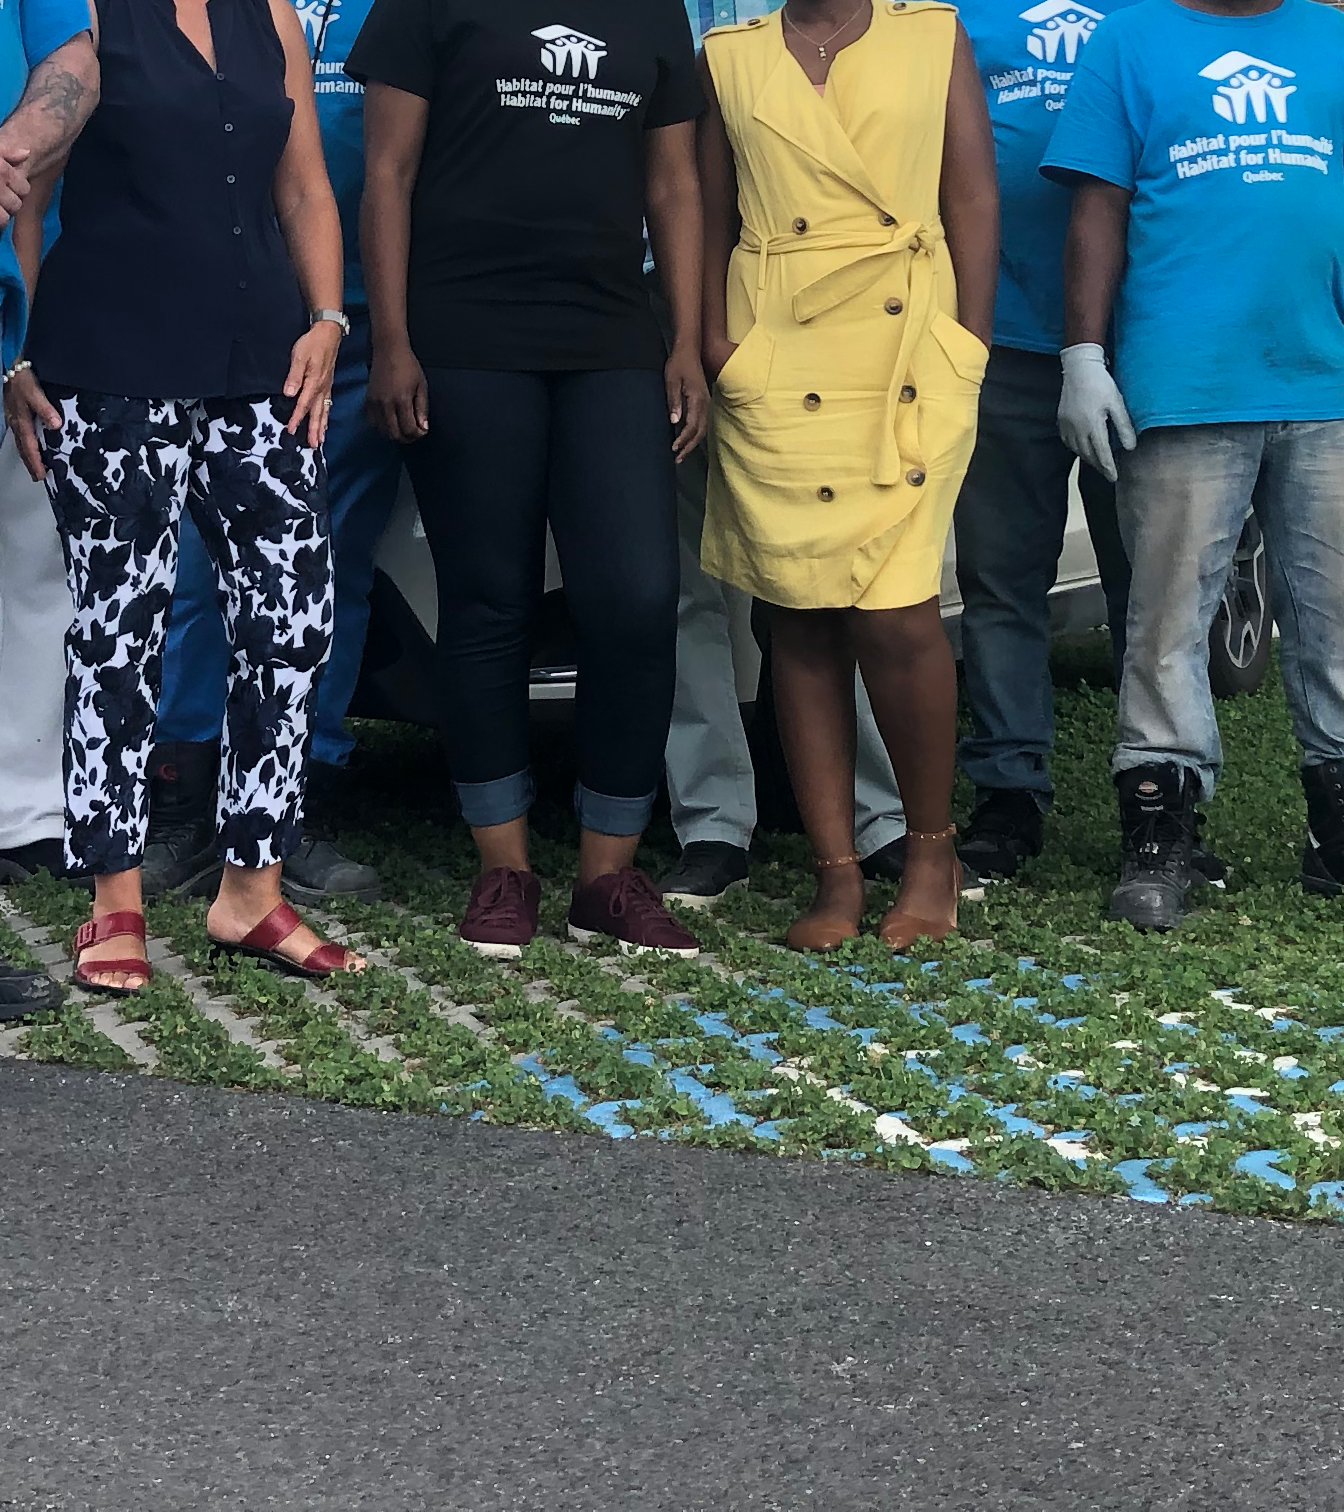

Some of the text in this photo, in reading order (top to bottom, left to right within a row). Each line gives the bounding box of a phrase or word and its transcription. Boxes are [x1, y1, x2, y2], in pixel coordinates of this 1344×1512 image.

[496, 78, 544, 93] Habitat
[544, 82, 576, 96] pour
[989, 66, 1074, 90] Habitat pour
[500, 93, 547, 108] Habitat
[549, 95, 570, 110] for
[997, 80, 1068, 105] Habitat for
[549, 112, 581, 126] Québec
[1169, 133, 1226, 162] Habitat
[1228, 133, 1268, 151] pour
[1176, 152, 1237, 179] Habitat
[1239, 149, 1265, 166] for
[1242, 170, 1285, 184] Québec
